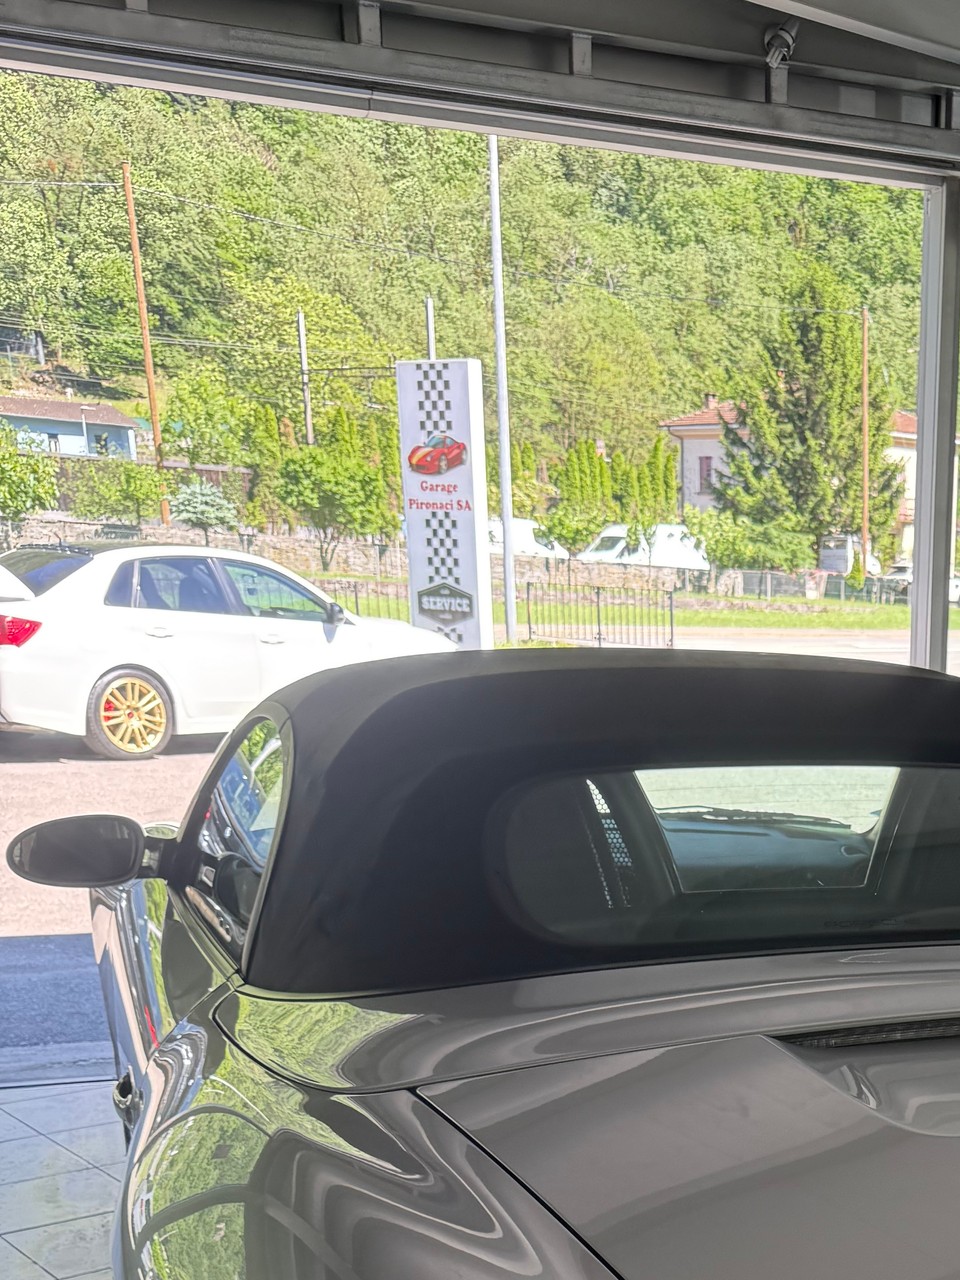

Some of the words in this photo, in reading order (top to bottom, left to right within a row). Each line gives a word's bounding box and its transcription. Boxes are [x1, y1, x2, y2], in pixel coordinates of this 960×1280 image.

[420, 480, 459, 495] Garage
[408, 498, 454, 510] Pironaci
[456, 499, 472, 511] SA
[421, 595, 471, 612] SERVICE
